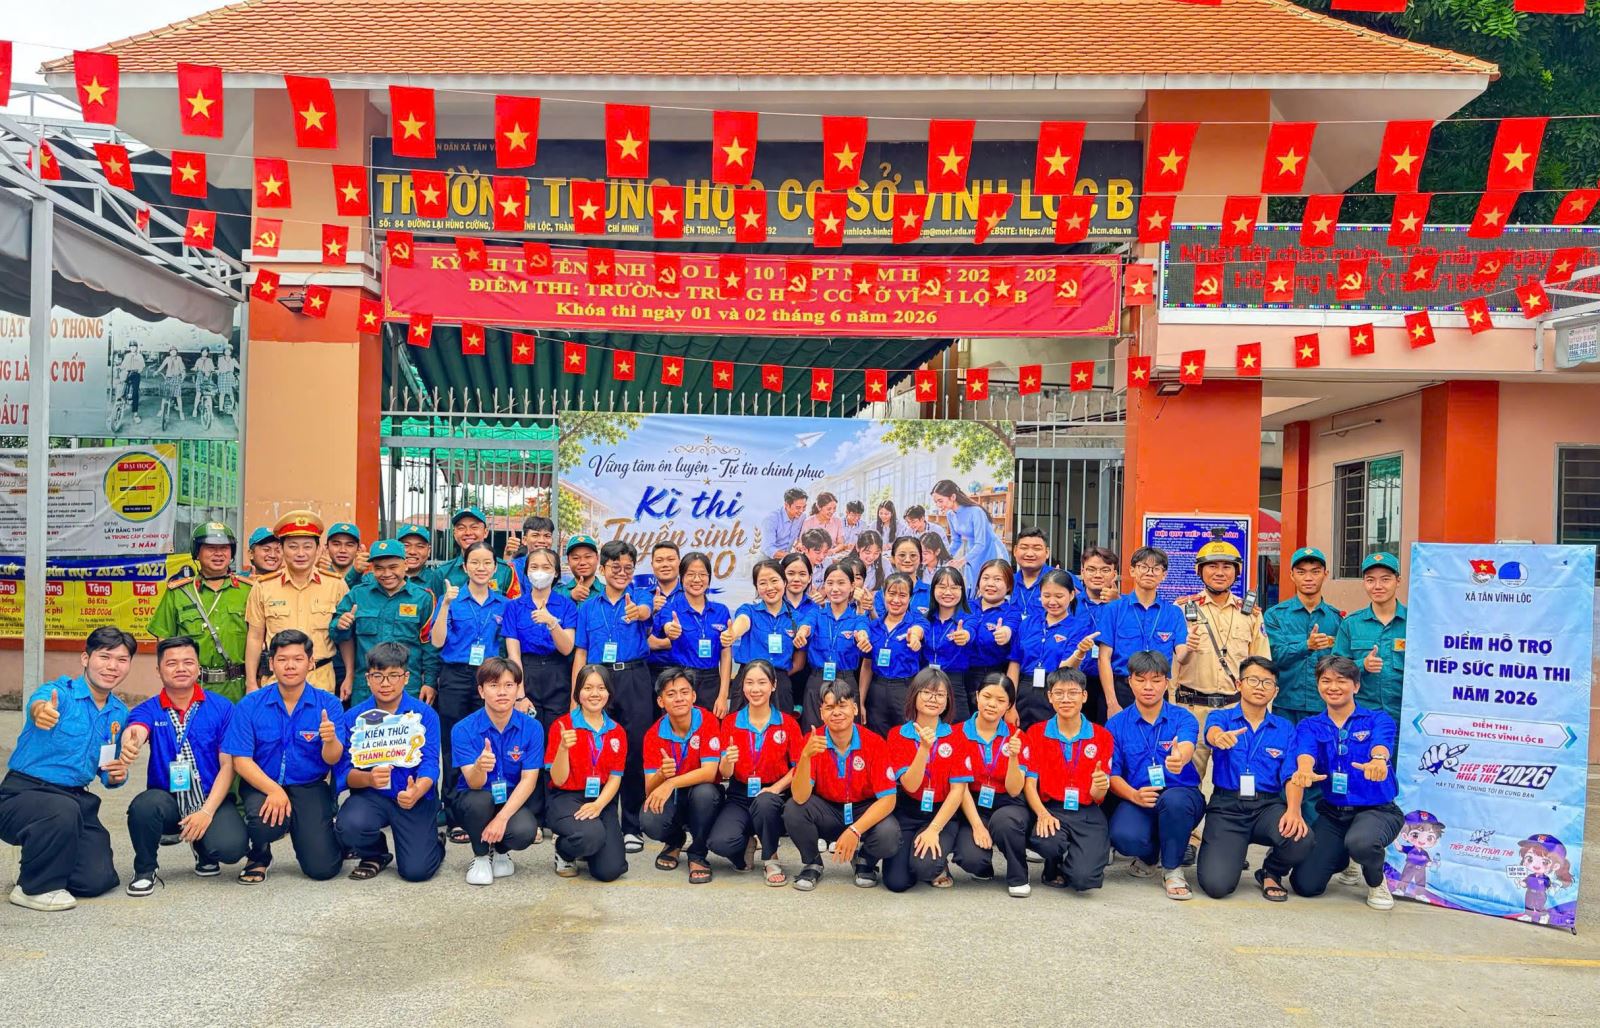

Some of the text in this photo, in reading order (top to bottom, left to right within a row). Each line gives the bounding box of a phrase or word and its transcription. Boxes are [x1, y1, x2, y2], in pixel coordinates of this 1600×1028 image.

[377, 166, 530, 217] TRỜN
[543, 177, 671, 220] TUN
[685, 178, 764, 228] HỌ
[1107, 179, 1134, 221] B
[379, 219, 391, 228] SỐ:
[395, 220, 404, 228] 84
[407, 218, 431, 229] ĐƯỜNG
[432, 220, 444, 230] LẠI
[555, 222, 574, 232] THÀN
[607, 223, 619, 233] CHÍ
[621, 224, 639, 233] MINH
[683, 224, 695, 235] IỆN
[991, 227, 1018, 236] EBSITE:
[431, 252, 461, 270] KỲ
[485, 258, 507, 271] HI
[754, 266, 775, 280] 10
[957, 268, 989, 282] 202
[1024, 268, 1057, 282] 202
[533, 281, 579, 296] THI:
[686, 286, 764, 301] TRG
[896, 287, 953, 304] VĨH
[959, 287, 990, 307] LỘ
[1014, 290, 1028, 304] B
[556, 302, 938, 326] Khóa thi ngày 01 và 02 tháng 6 năm 2026
[62, 351, 86, 382] TỐT
[588, 452, 630, 479] Vững
[633, 457, 655, 474] tâm
[658, 458, 674, 473] ôn
[676, 457, 710, 479] luyện
[719, 457, 739, 482] Tự
[741, 461, 758, 476] tin
[761, 462, 794, 479] chinh
[794, 467, 825, 483] phục
[634, 486, 745, 523] Kì thi
[690, 519, 748, 549] sinh
[135, 563, 165, 577] 2027
[0, 582, 156, 596] ặng ặng Tặng Tặng
[1477, 591, 1494, 603] TÂN
[1495, 591, 1515, 603] VĨNH
[1443, 630, 1553, 657] ĐIỂM HỖ TRỢ
[1425, 656, 1570, 682] TIẾP SỨC MÙA THI
[1452, 686, 1538, 706] NĂM 2026
[364, 724, 410, 739] KIẾN THỨC
[1472, 718, 1493, 730] ĐIỂM
[1476, 732, 1497, 740] THCS
[1498, 765, 1553, 788] 2026
